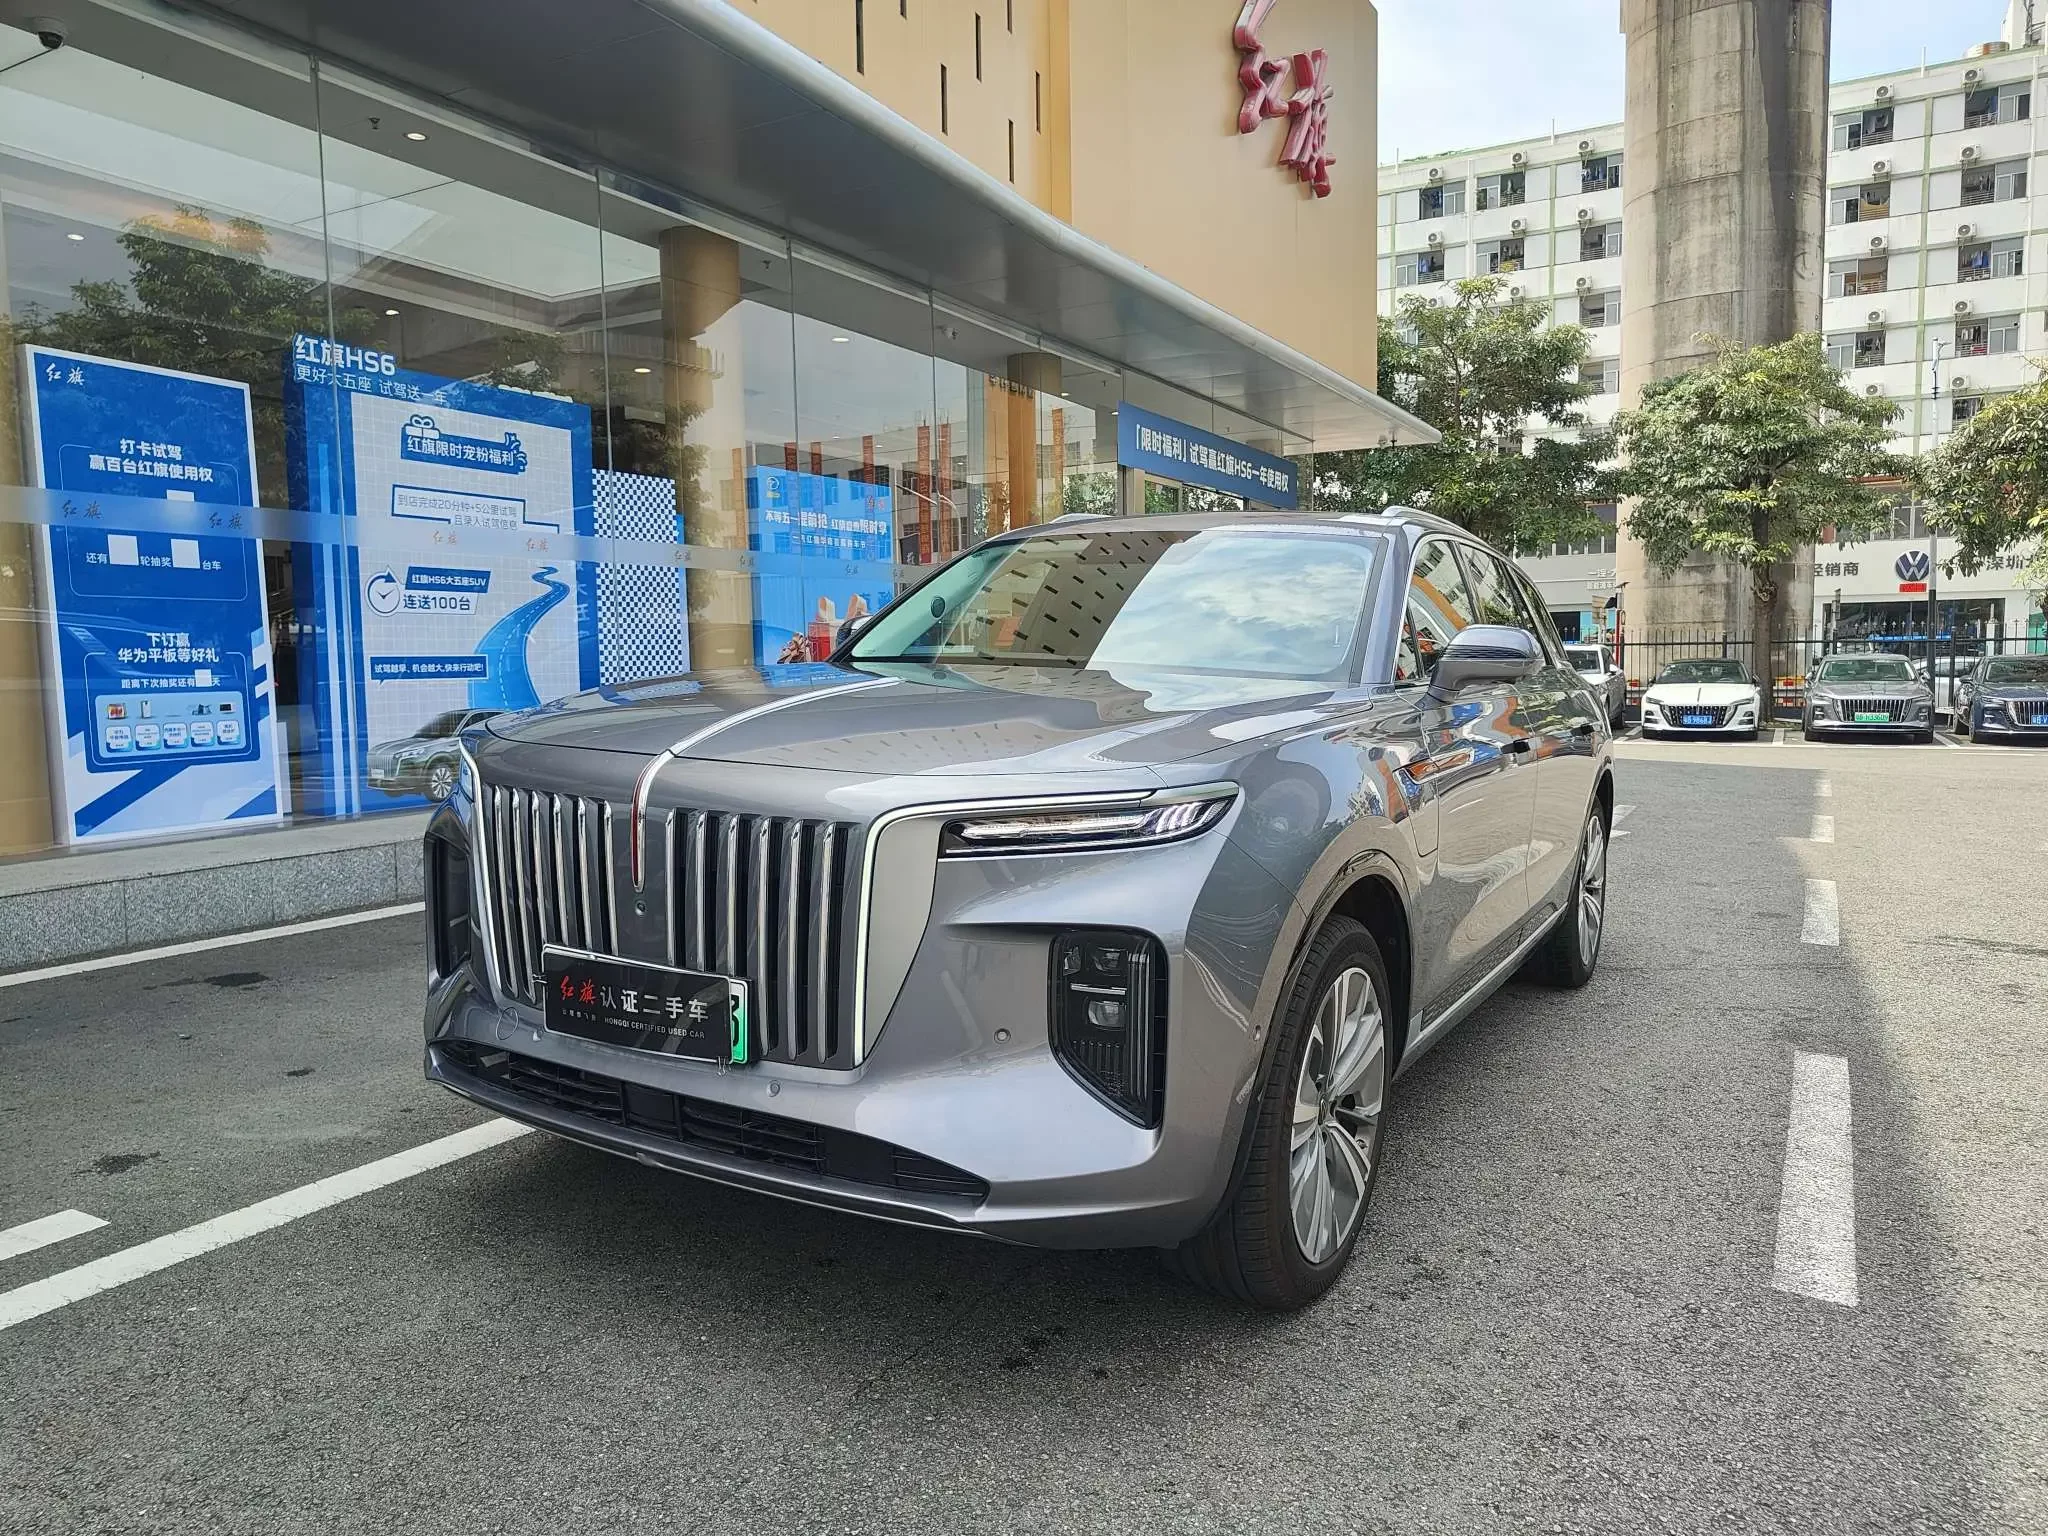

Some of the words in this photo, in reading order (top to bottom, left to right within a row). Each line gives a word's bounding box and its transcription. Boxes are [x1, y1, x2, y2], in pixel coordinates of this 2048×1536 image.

[293, 334, 396, 376] 红旗HS6
[45, 363, 85, 387] 红旗
[120, 438, 182, 461] 打卡试驾
[407, 436, 514, 467] 红旗限时宠粉福利
[89, 454, 213, 483] 赢百台红旗使用权
[86, 552, 107, 564] 还有
[202, 560, 222, 571] 台车
[403, 594, 471, 611] 连送100台
[147, 633, 190, 647] 下订赢
[118, 648, 219, 663] 华为平板等好礼
[121, 677, 196, 689] 距离下次抽奖还有
[560, 975, 597, 1005] 红旗
[600, 986, 709, 1022] 认证二手车
[604, 1017, 630, 1028] HONGQI
[631, 1021, 666, 1034] CERTIFIED
[668, 1028, 688, 1038] USED
[689, 1030, 705, 1040] CAR
